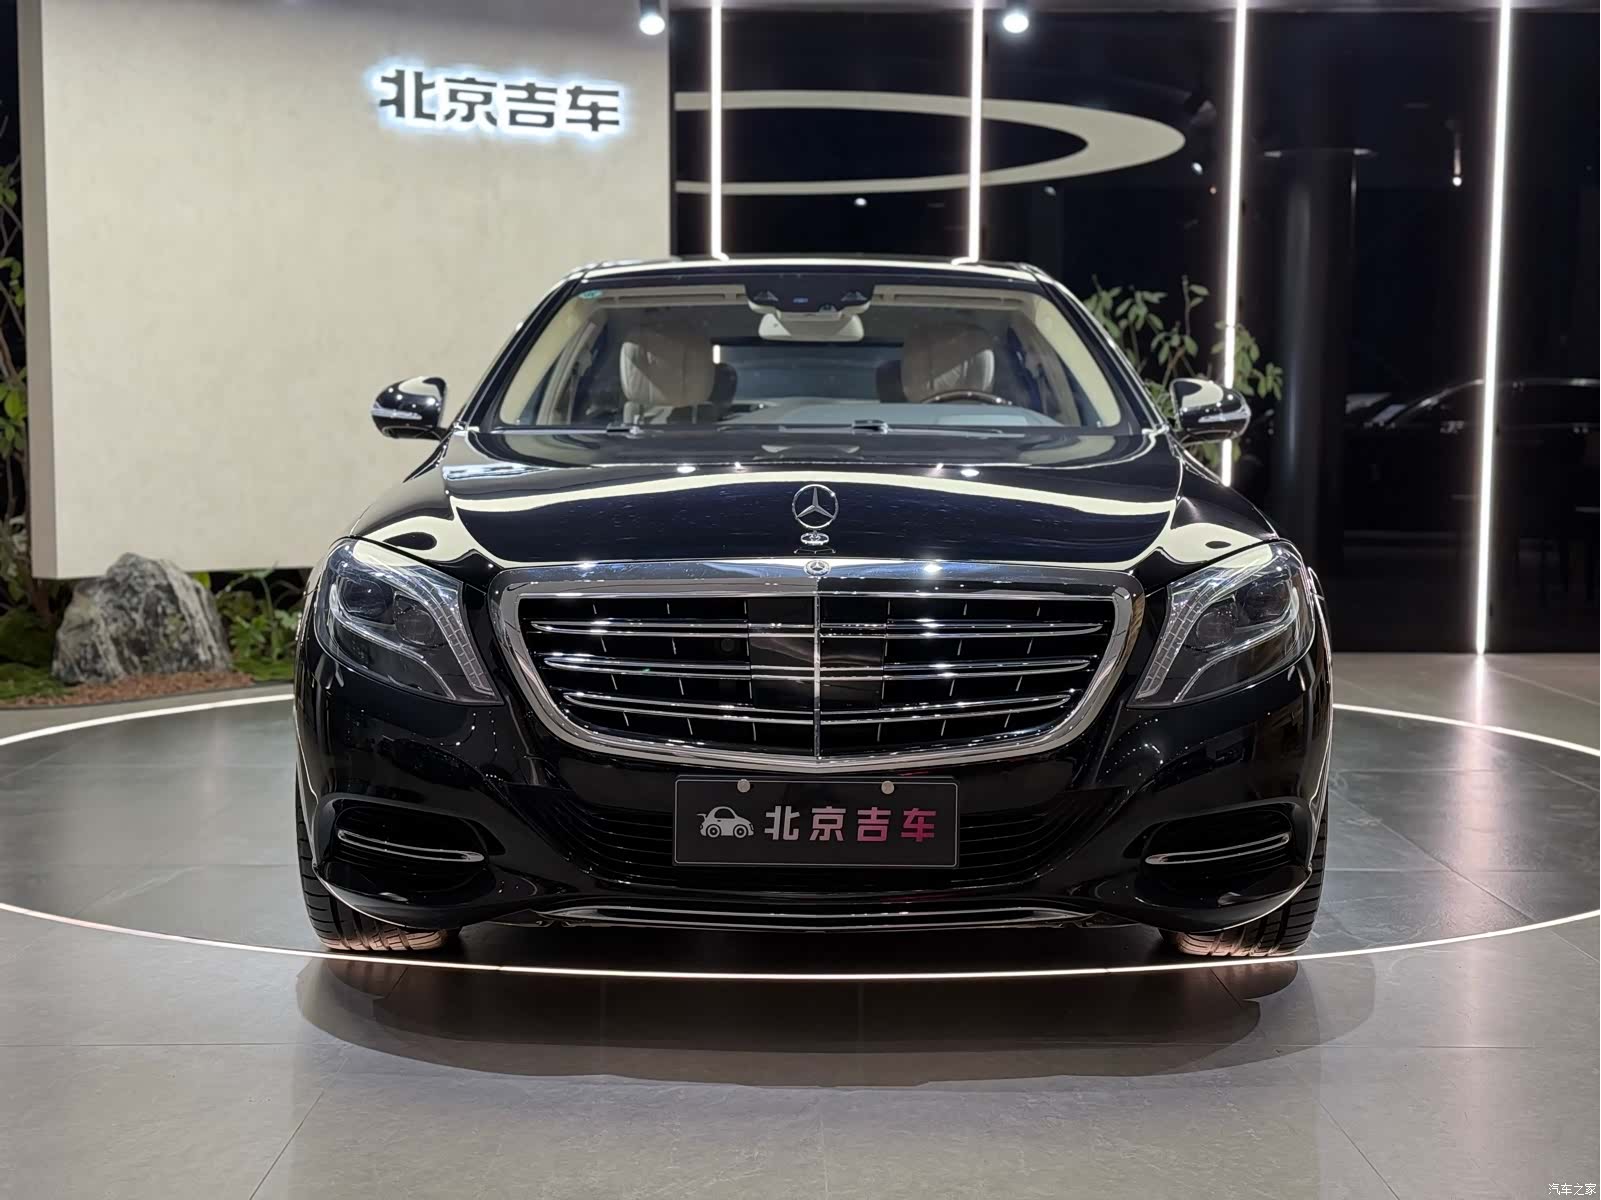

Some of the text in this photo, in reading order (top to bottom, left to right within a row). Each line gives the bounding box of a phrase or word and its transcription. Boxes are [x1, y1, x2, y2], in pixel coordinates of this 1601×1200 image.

[379, 69, 619, 132] 北京吉车
[764, 805, 937, 842] 北京吉车
